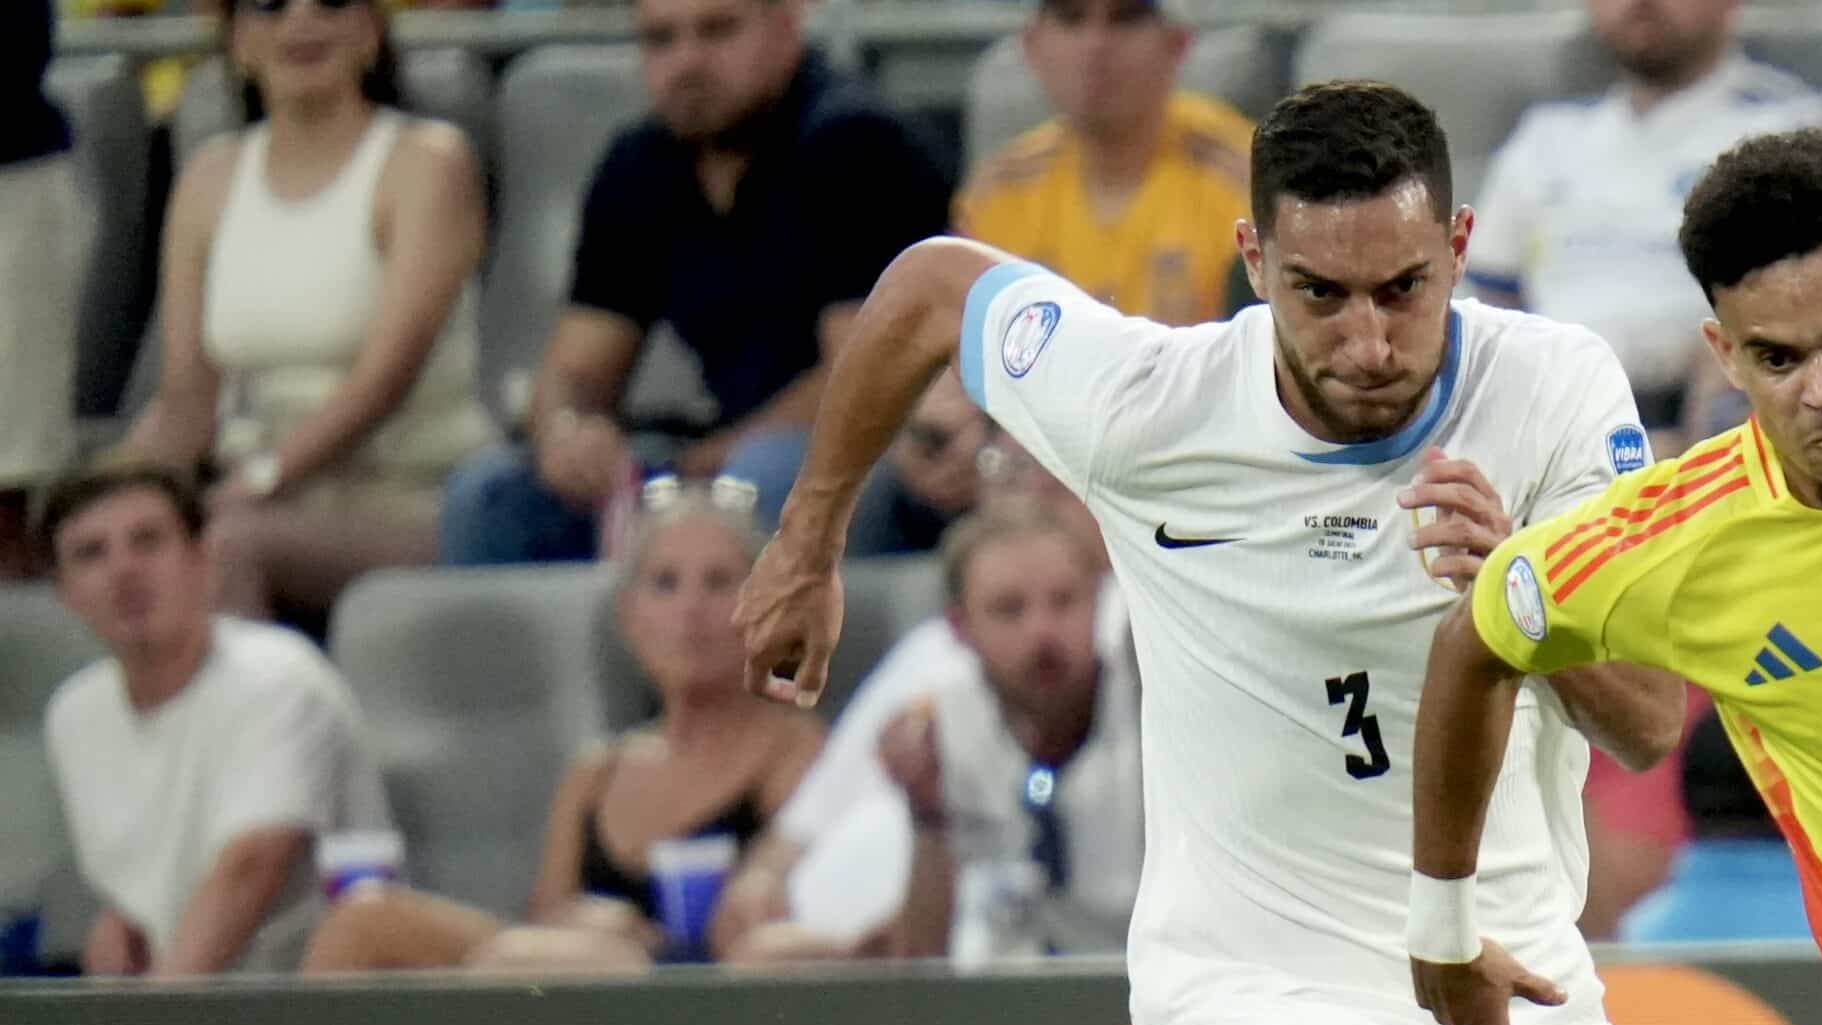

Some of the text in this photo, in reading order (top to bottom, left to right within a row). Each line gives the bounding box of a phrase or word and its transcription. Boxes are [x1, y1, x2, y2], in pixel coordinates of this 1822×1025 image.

[1304, 515, 1378, 530] VS. COLOMBIA
[1325, 670, 1390, 780] 3
